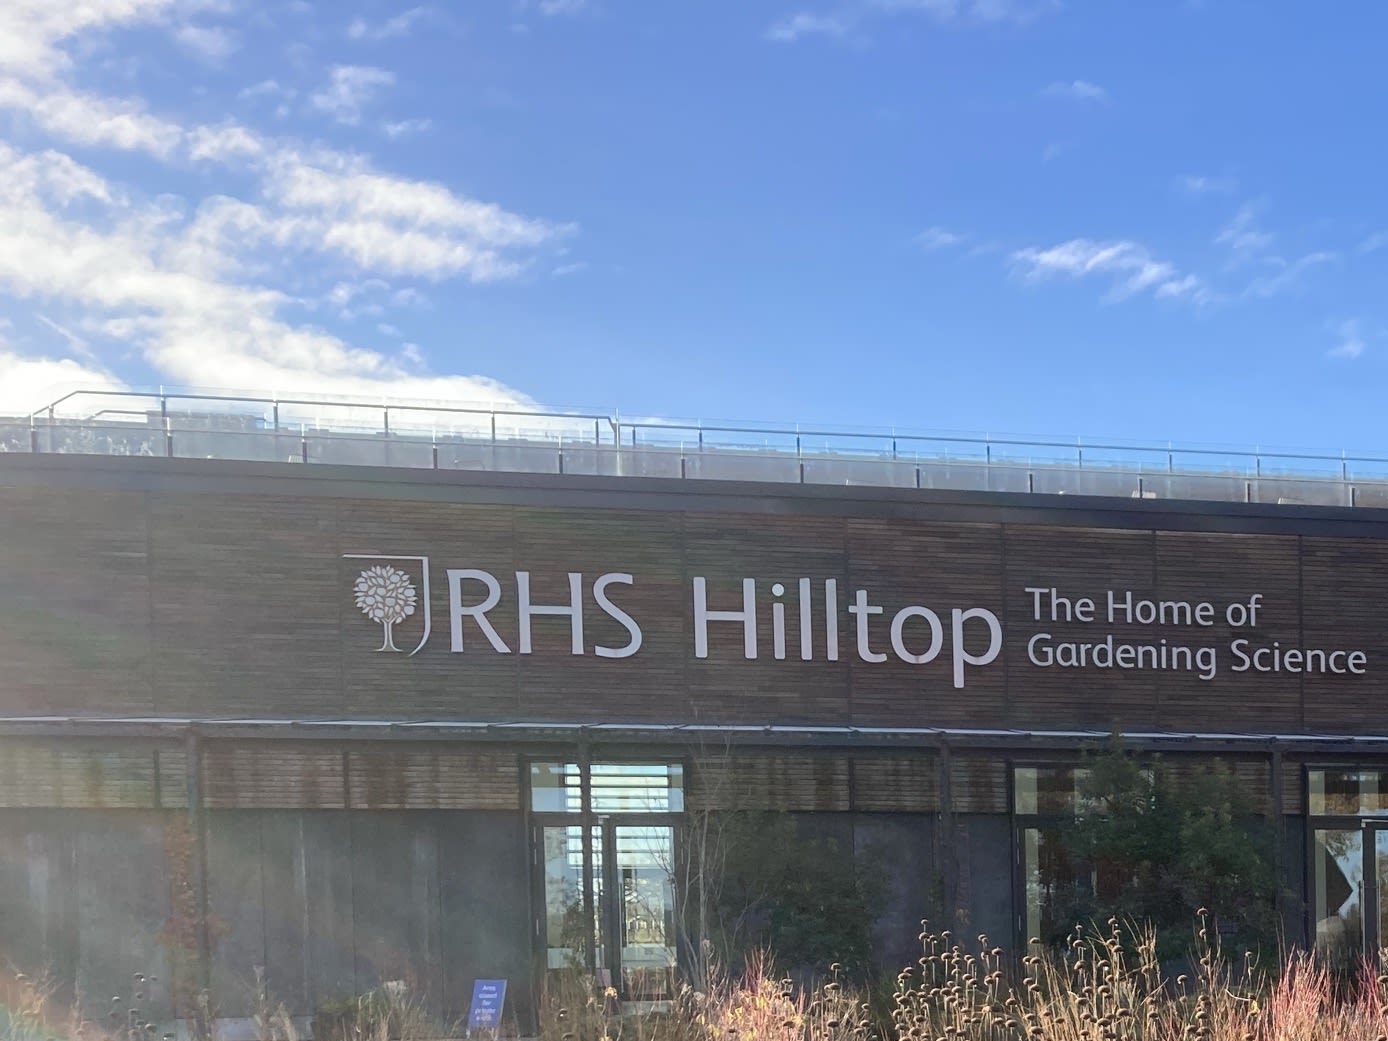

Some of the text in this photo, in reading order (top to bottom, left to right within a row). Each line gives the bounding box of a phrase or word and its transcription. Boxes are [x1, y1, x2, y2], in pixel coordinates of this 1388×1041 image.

[446, 569, 1003, 689] RHS Hilltop
[1024, 587, 1263, 627] The Home of
[1027, 633, 1368, 680] Gardening Science
